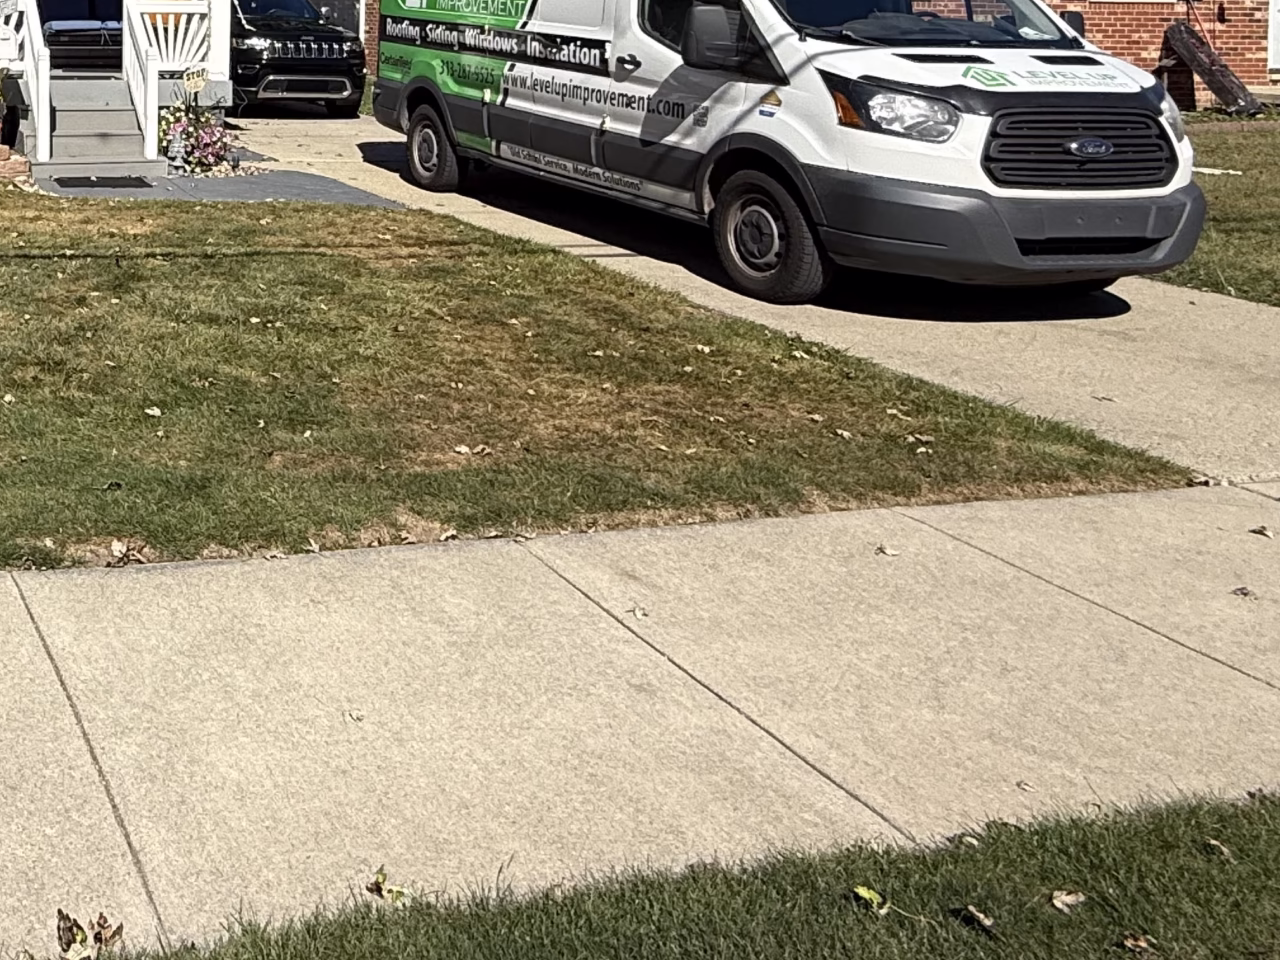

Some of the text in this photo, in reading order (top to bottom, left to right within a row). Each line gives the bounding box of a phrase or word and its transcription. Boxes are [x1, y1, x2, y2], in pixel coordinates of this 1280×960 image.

[386, 17, 420, 45] Roofing
[425, 23, 459, 50] Siding
[464, 27, 518, 54] Windows
[1011, 70, 1091, 79] LEVEL
[502, 71, 686, 119] www.levelupimprovement.com
